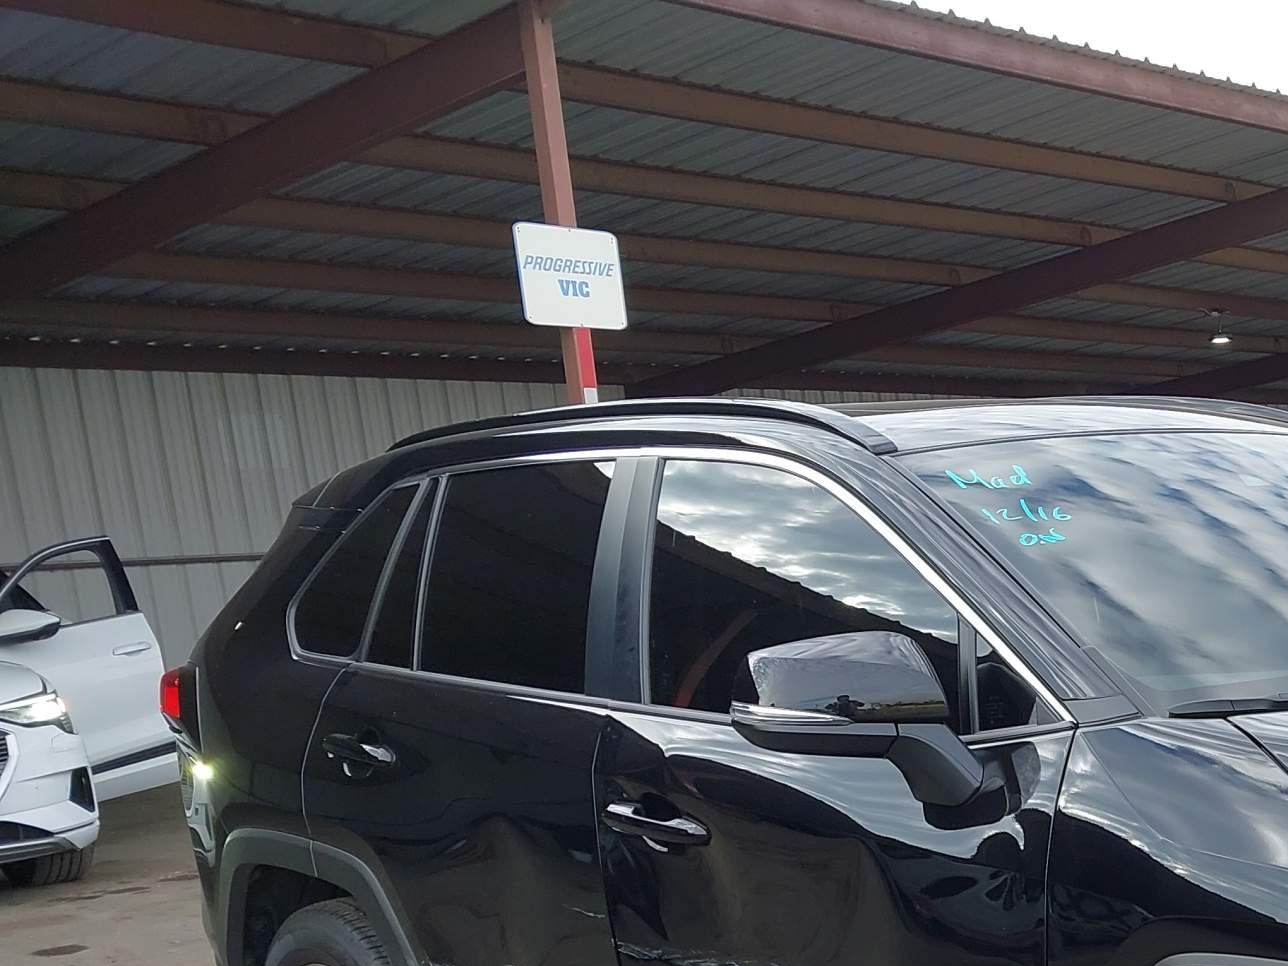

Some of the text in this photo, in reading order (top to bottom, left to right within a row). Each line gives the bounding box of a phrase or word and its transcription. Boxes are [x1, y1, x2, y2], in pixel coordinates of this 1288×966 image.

[523, 254, 615, 277] PROGRESSIVE
[557, 279, 591, 298] VIC
[981, 498, 1073, 525] 12/16
